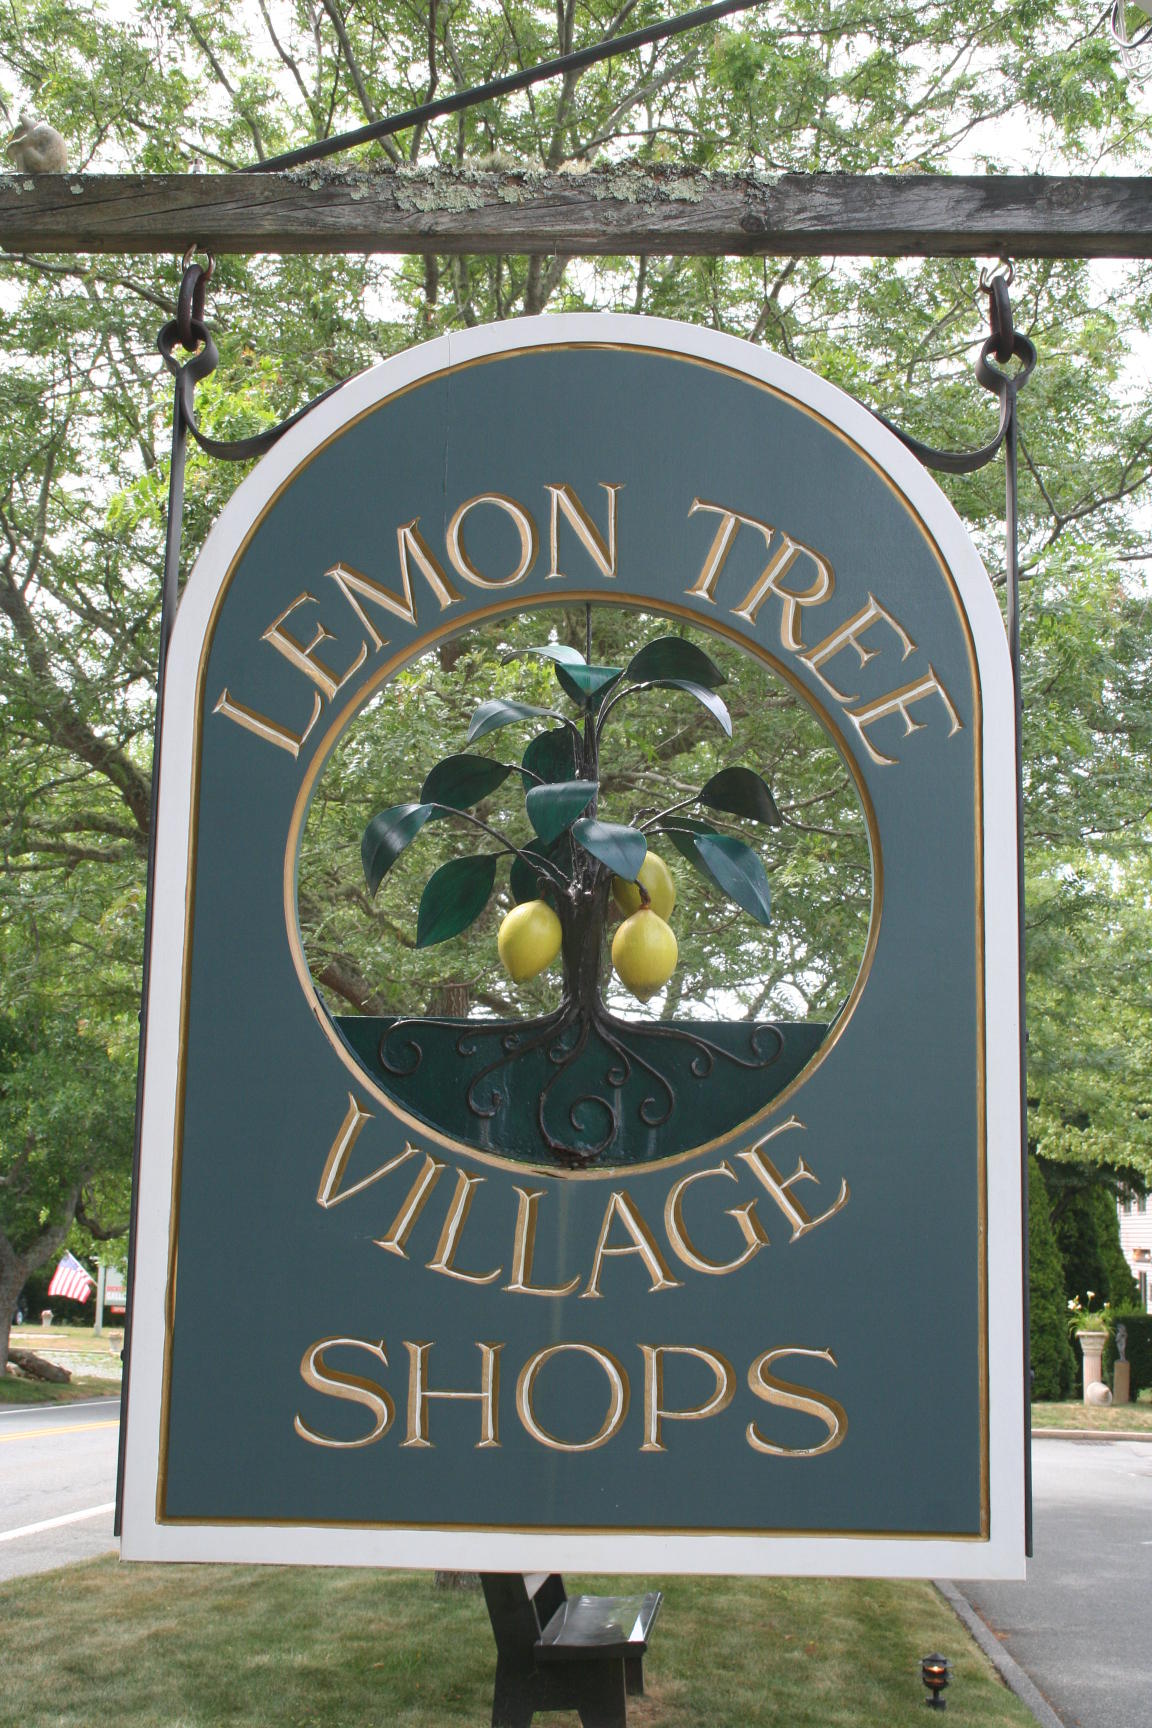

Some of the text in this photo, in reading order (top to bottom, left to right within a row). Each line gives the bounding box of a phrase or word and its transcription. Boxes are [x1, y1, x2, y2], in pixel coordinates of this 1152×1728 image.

[212, 482, 963, 765] LEMON TREE
[315, 1092, 850, 1299] VILLAGE
[294, 1335, 848, 1457] SHOPS
